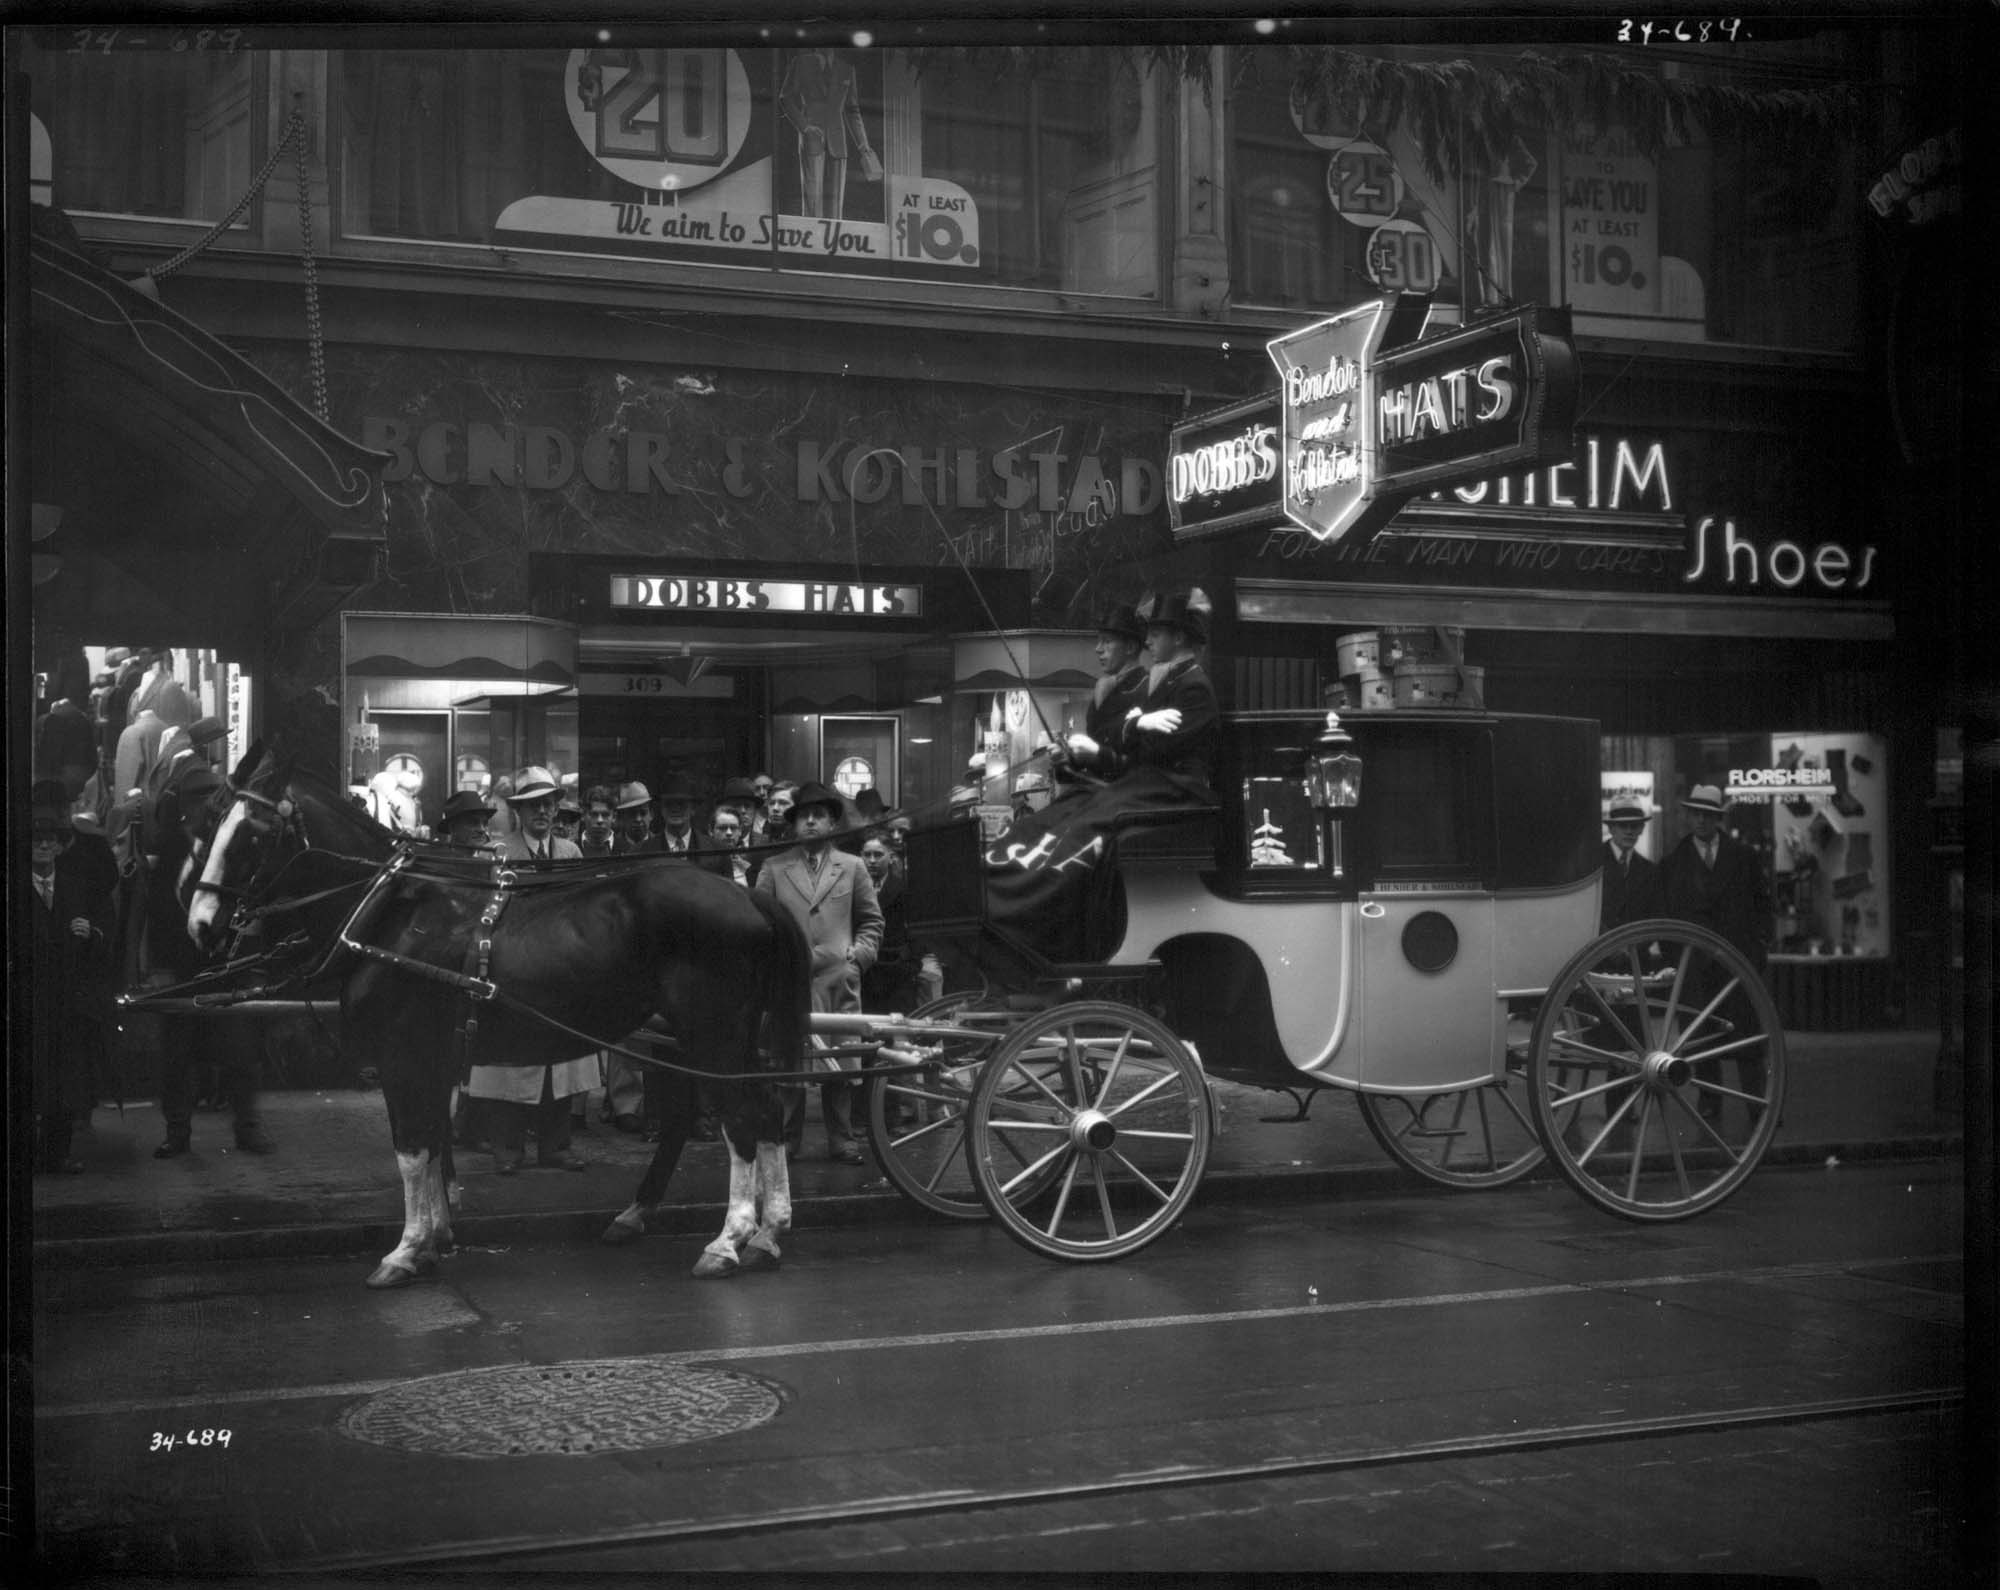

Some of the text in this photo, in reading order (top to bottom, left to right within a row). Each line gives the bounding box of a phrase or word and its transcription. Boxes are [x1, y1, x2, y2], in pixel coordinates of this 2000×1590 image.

[903, 194, 968, 213] AT LEAST
[1607, 180, 1648, 214] YOU
[611, 203, 875, 254] We aim to Save You
[1572, 219, 1641, 237] AT LEAST
[1379, 353, 1513, 449] HATS
[799, 439, 1162, 516] KOHLSTAD
[1258, 533, 1323, 560] FOR
[1406, 539, 1479, 565] MAN
[1497, 541, 1561, 569] WHO
[1684, 516, 1878, 590] Shoes
[627, 577, 905, 616] DOBBS HATS
[1728, 768, 1832, 786] FLORSHEIM
